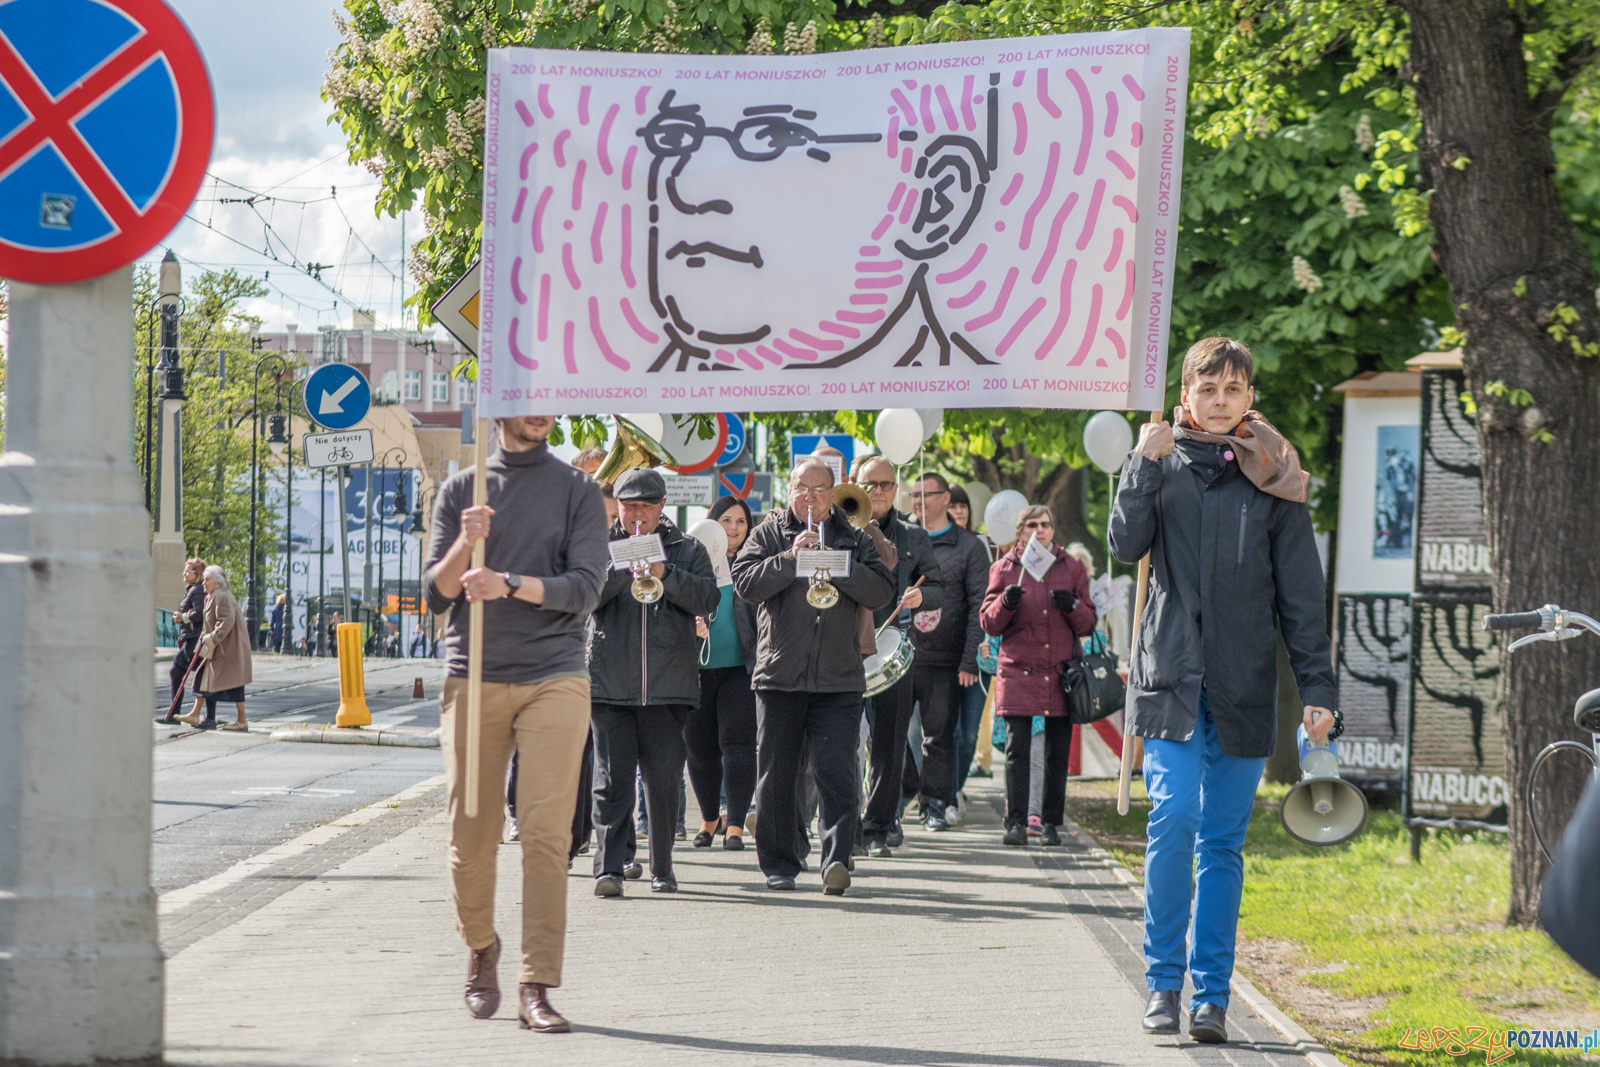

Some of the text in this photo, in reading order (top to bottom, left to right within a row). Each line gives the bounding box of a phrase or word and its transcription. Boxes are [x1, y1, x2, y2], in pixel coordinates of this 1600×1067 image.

[997, 43, 1150, 64] 200 LAT MONIUSZKO!
[510, 63, 663, 79] 200 LAT MONIUSZKO!
[836, 55, 985, 77] 200 LAT MONIUSZKO!
[675, 68, 827, 81] 200 LAT MONIUSZKO!
[1157, 55, 1180, 217] 200 LAT MONIUSZKO!
[485, 73, 501, 228] 200 LAT MONIUSZKO!
[480, 239, 496, 394] 200 LAT MONIUSZKO!
[1143, 228, 1167, 389] 200 LAT MONIUSZKO!
[660, 384, 811, 399] 200 LAT MONIUSZKO!
[821, 379, 971, 395] 200 LAT MONIUSZKO!
[982, 377, 1132, 393] 200 LAT MONIUSZKO!
[501, 386, 648, 402] 200 LAT MONIUSZKO!
[315, 434, 362, 445] Nie dotyczy
[347, 540, 408, 554] AGOBEX
[1337, 741, 1405, 769] NABUC
